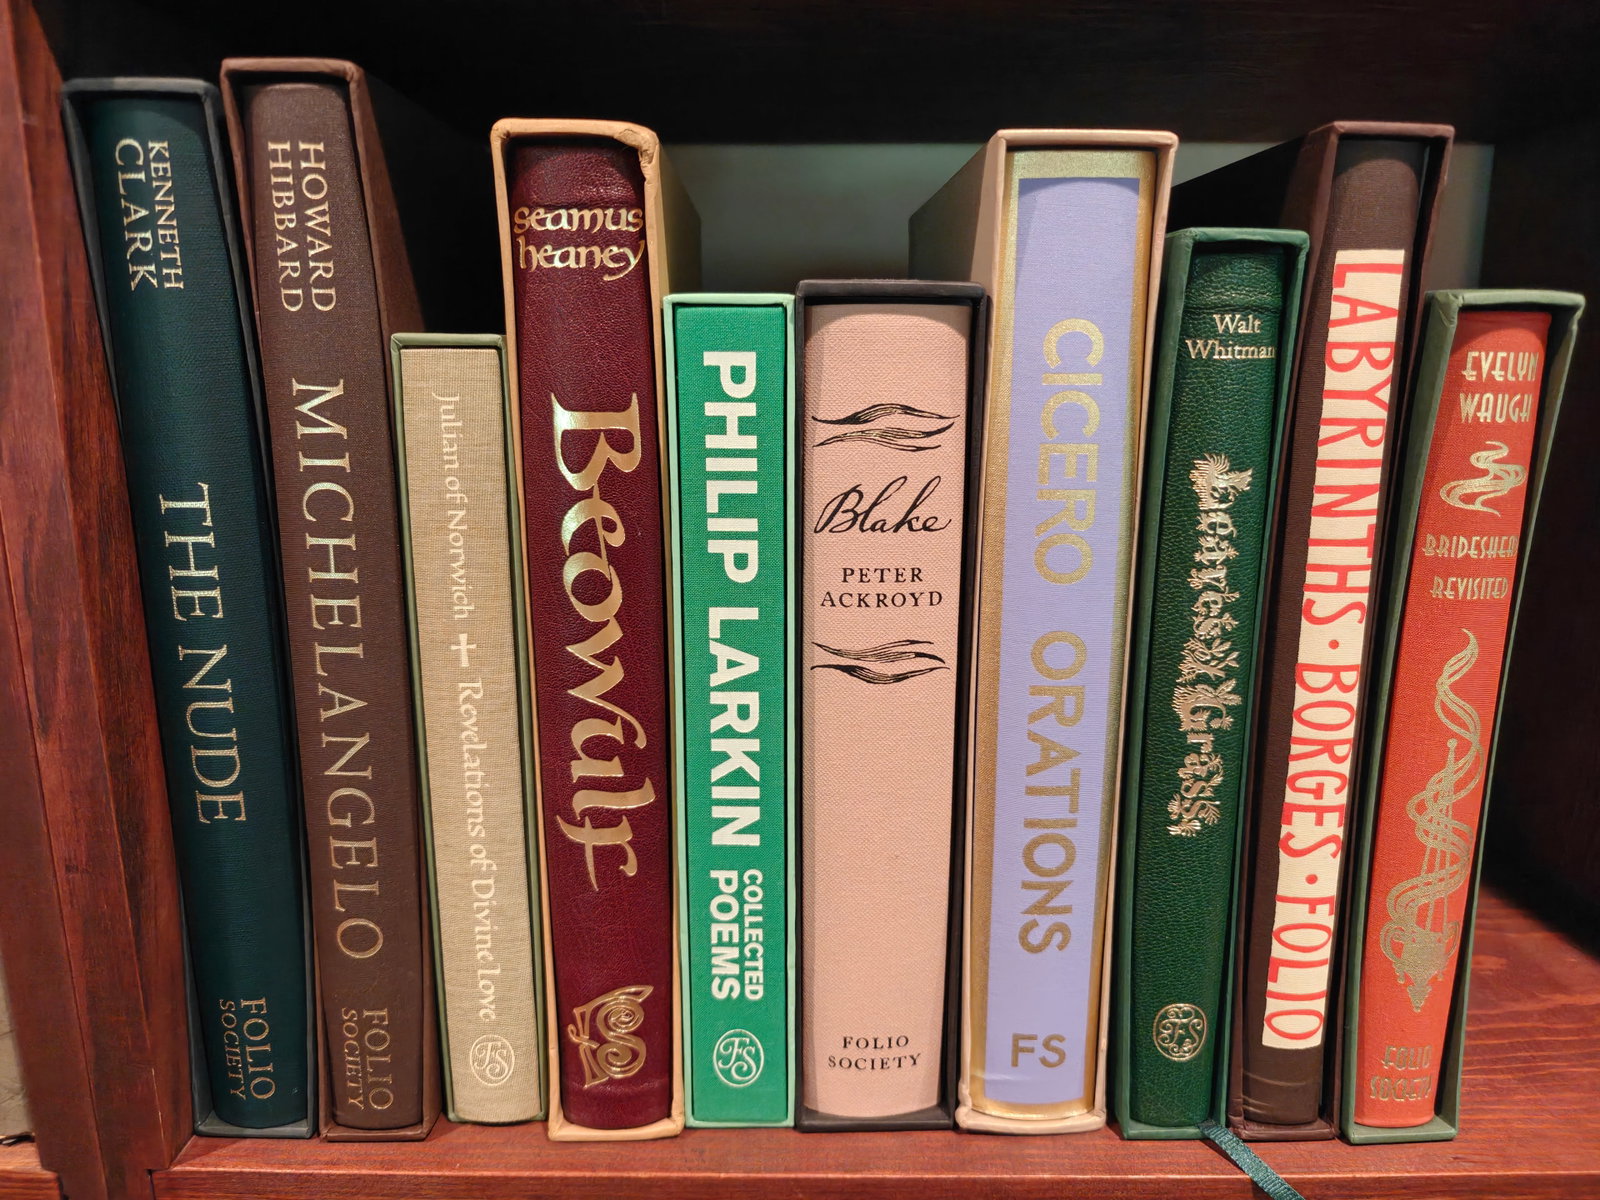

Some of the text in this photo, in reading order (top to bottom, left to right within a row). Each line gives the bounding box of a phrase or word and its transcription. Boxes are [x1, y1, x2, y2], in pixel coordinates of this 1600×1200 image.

[115, 138, 158, 291] CLARK
[148, 139, 184, 290] KENNETH
[268, 141, 303, 312] HIBBARD
[299, 141, 337, 312] HOWARD
[514, 205, 643, 234] seamus
[518, 235, 645, 282] heaney
[1184, 338, 1276, 360] Whitman
[1212, 313, 1263, 334] Walt
[1461, 351, 1539, 382] EVELYN
[431, 392, 463, 471] Julian
[1459, 392, 1533, 424] WAUGH
[445, 476, 468, 503] of
[813, 475, 952, 534] Blake
[447, 509, 475, 621] Norwich
[702, 351, 761, 847] PHILIP LARKIN
[820, 590, 943, 608] ACKROYD
[841, 567, 924, 584] PETER
[1429, 576, 1508, 600] REVISITED
[159, 482, 248, 824] THE NUDE
[291, 377, 384, 959] MICHELANGELO
[551, 391, 656, 892] Beowulf
[1017, 317, 1105, 955] CICERO ORATIONS
[1264, 262, 1403, 1041] LABYRINTHS BORGES FOLIO
[458, 676, 491, 838] Revelations
[469, 843, 498, 871] of
[471, 877, 499, 963] Divine
[709, 868, 741, 1001] POEMS
[742, 868, 765, 1001] COLLECTED
[219, 998, 247, 1101] SOCIETY
[240, 996, 276, 1100] FOLIO
[341, 1006, 365, 1111] SOCIETY
[363, 1006, 395, 1111] FOLIO
[828, 1052, 922, 1072] SOCIETY
[842, 1034, 910, 1050] FOLIO
[1010, 1033, 1067, 1069] FS
[1381, 1044, 1433, 1072] FOLIO
[1369, 1074, 1433, 1102] SOCIETY
